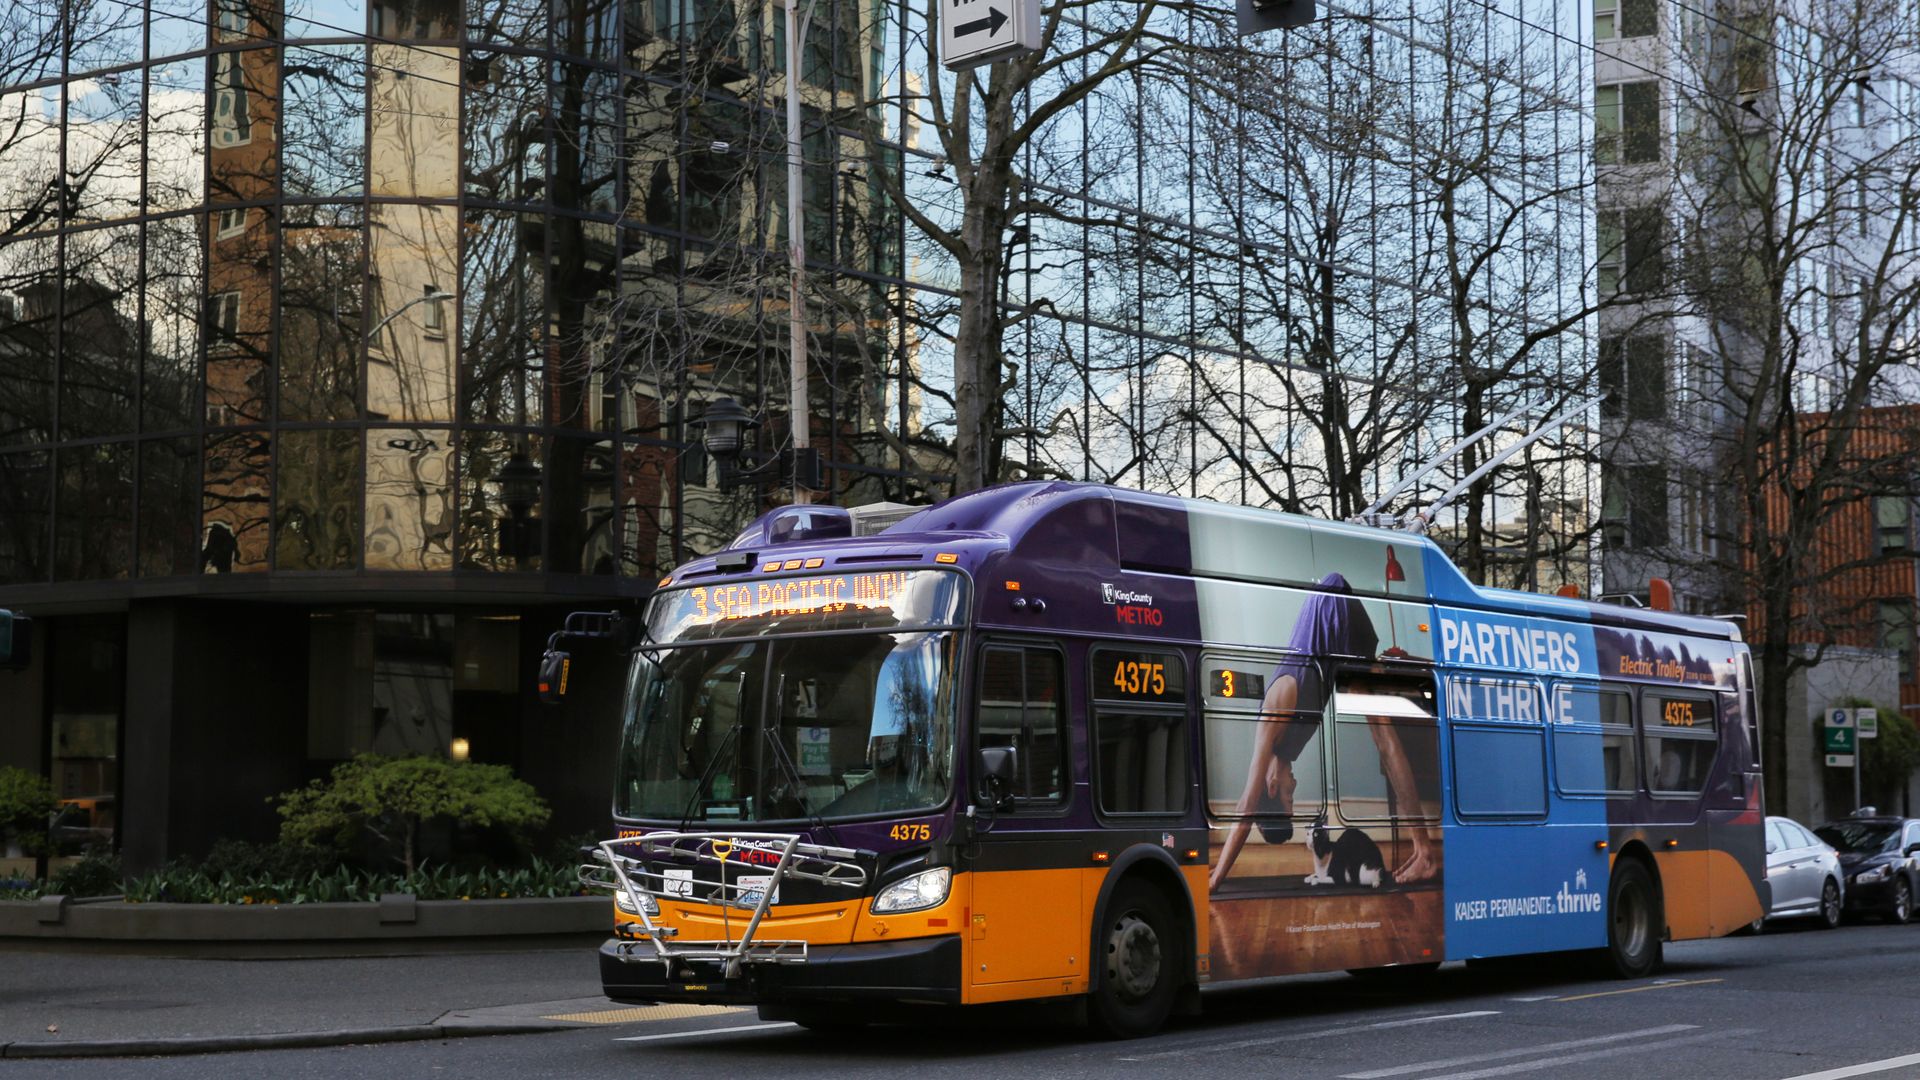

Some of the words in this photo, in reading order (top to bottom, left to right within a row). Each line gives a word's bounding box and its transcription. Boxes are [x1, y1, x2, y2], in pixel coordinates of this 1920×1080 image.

[691, 587, 708, 624] 3
[713, 586, 751, 620] SEA
[758, 577, 846, 616] PACIFIC
[1114, 589, 1130, 603] King
[1130, 591, 1153, 606] County
[1116, 605, 1163, 626] METRO
[1441, 618, 1580, 673] PARTNERS
[1113, 660, 1165, 695] 4375
[1620, 655, 1654, 675] Electric
[1656, 659, 1686, 683] Trolley
[1221, 669, 1234, 698] 3
[1479, 677, 1575, 725] THRIVE
[1665, 701, 1693, 726] 4375
[1834, 729, 1845, 743] 4
[742, 840, 755, 848] King
[755, 840, 773, 848] Count
[890, 824, 930, 841] 4375
[1455, 901, 1488, 921] KAISER
[1557, 881, 1601, 913] thrive
